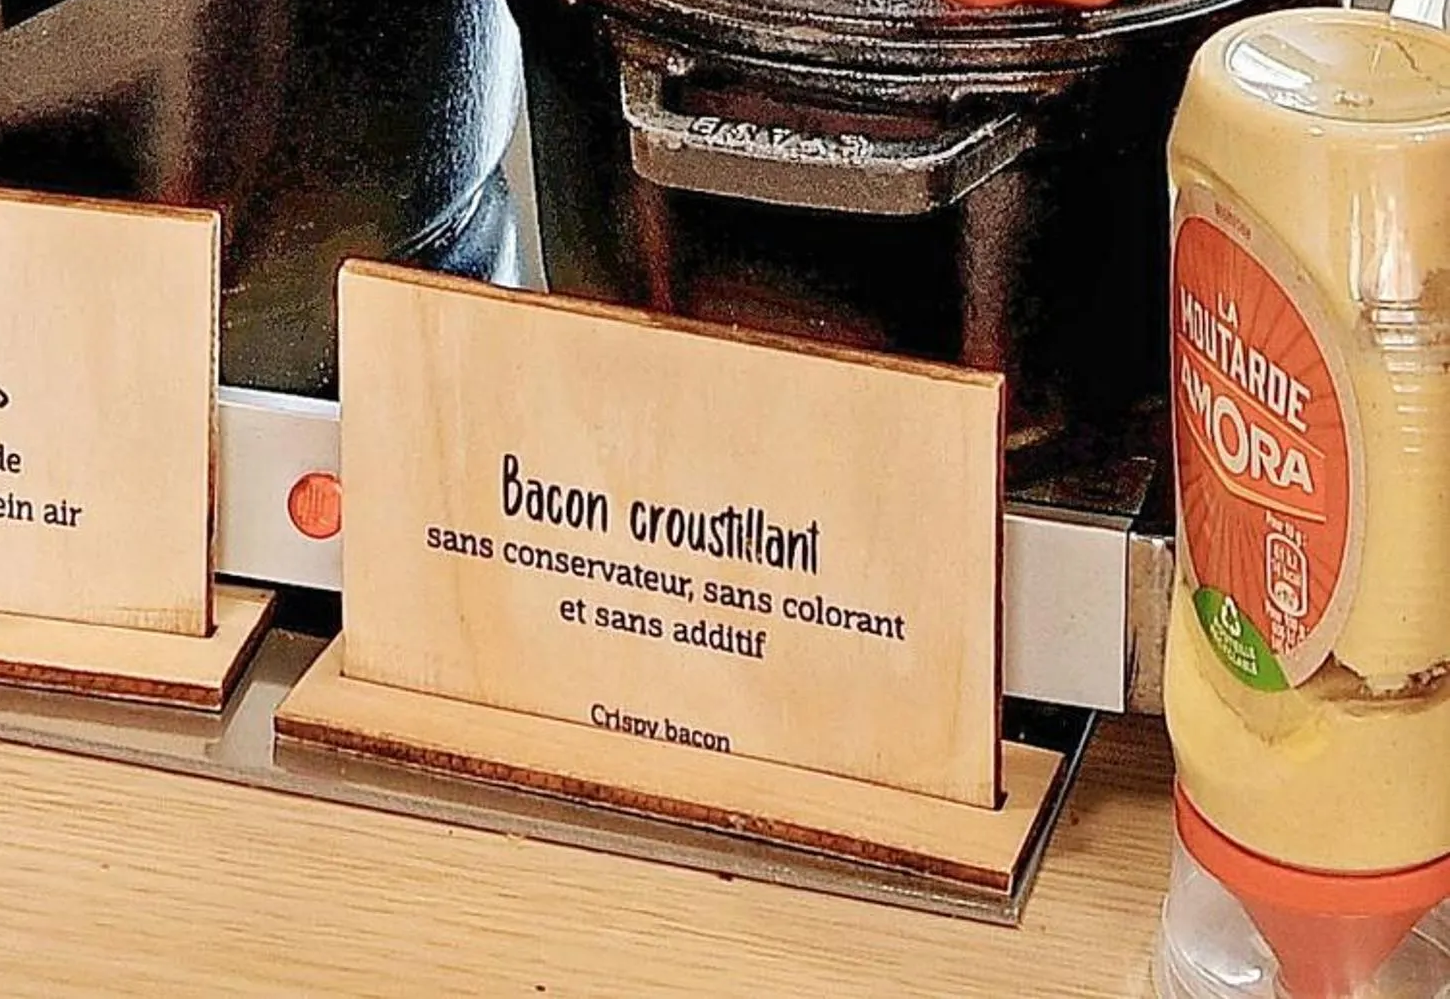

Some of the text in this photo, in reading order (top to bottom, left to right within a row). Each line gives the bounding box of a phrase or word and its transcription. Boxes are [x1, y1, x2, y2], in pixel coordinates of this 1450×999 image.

[1217, 291, 1239, 329] LA
[1180, 284, 1311, 433] MOUTARDE
[1180, 354, 1314, 494] AMORA
[43, 500, 82, 527] air
[502, 453, 819, 575] Bacon croustillant
[427, 527, 905, 641] sans conservateur, sans colorant
[559, 599, 767, 659] et sans additif
[591, 703, 731, 754] Crispy bacon
